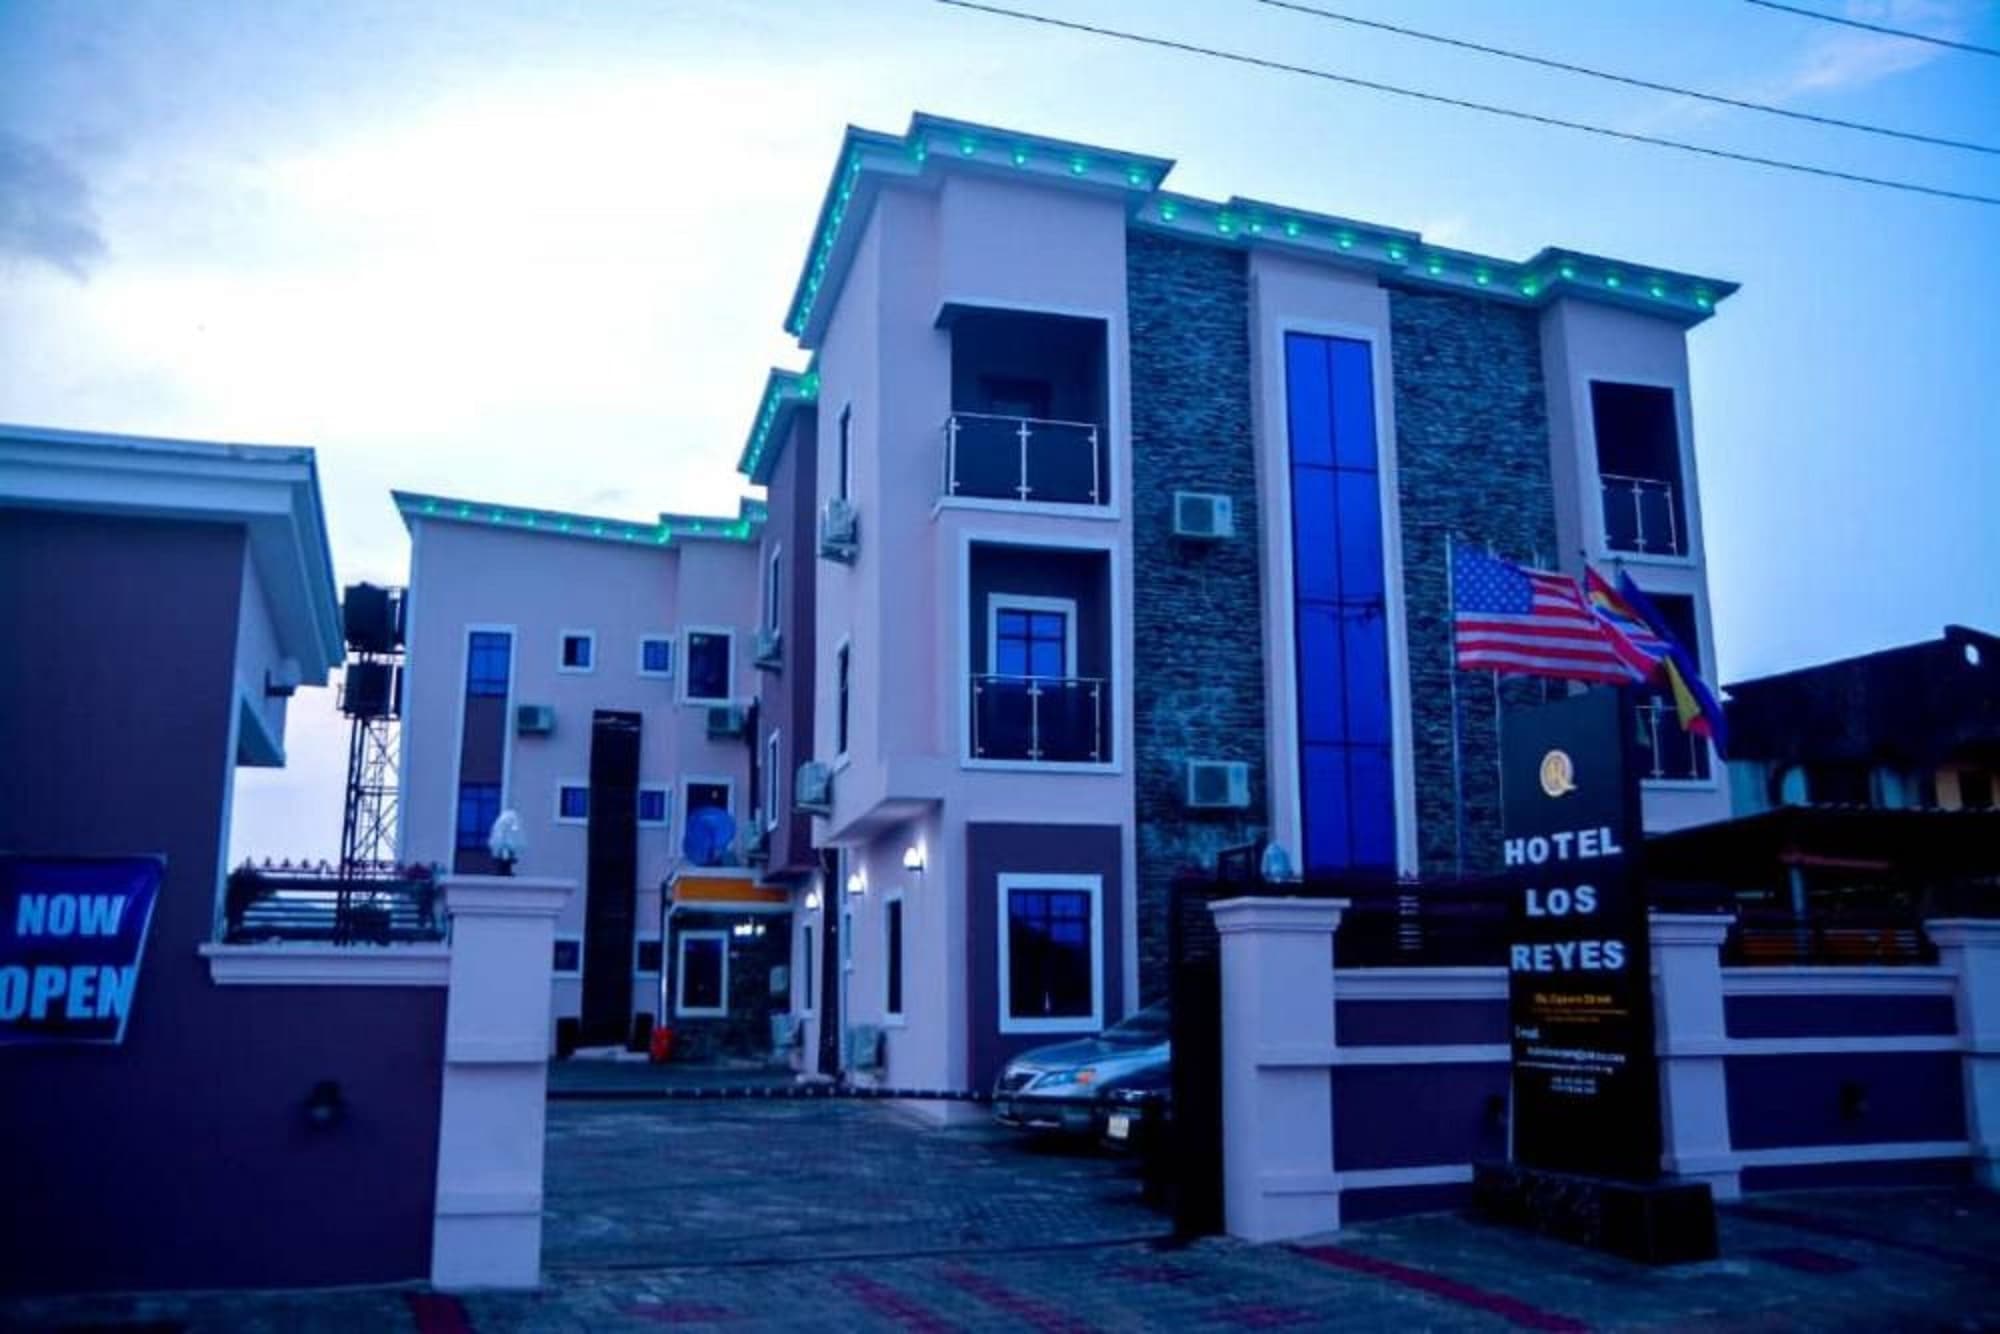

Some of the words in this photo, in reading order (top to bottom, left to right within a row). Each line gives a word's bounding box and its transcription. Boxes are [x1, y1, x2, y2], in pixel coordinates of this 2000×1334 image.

[1504, 827, 1622, 865] HOTEL
[16, 893, 125, 936] NOW
[1526, 885, 1597, 916] LOS
[1510, 940, 1625, 971] REYES
[0, 965, 135, 1020] OPEN
